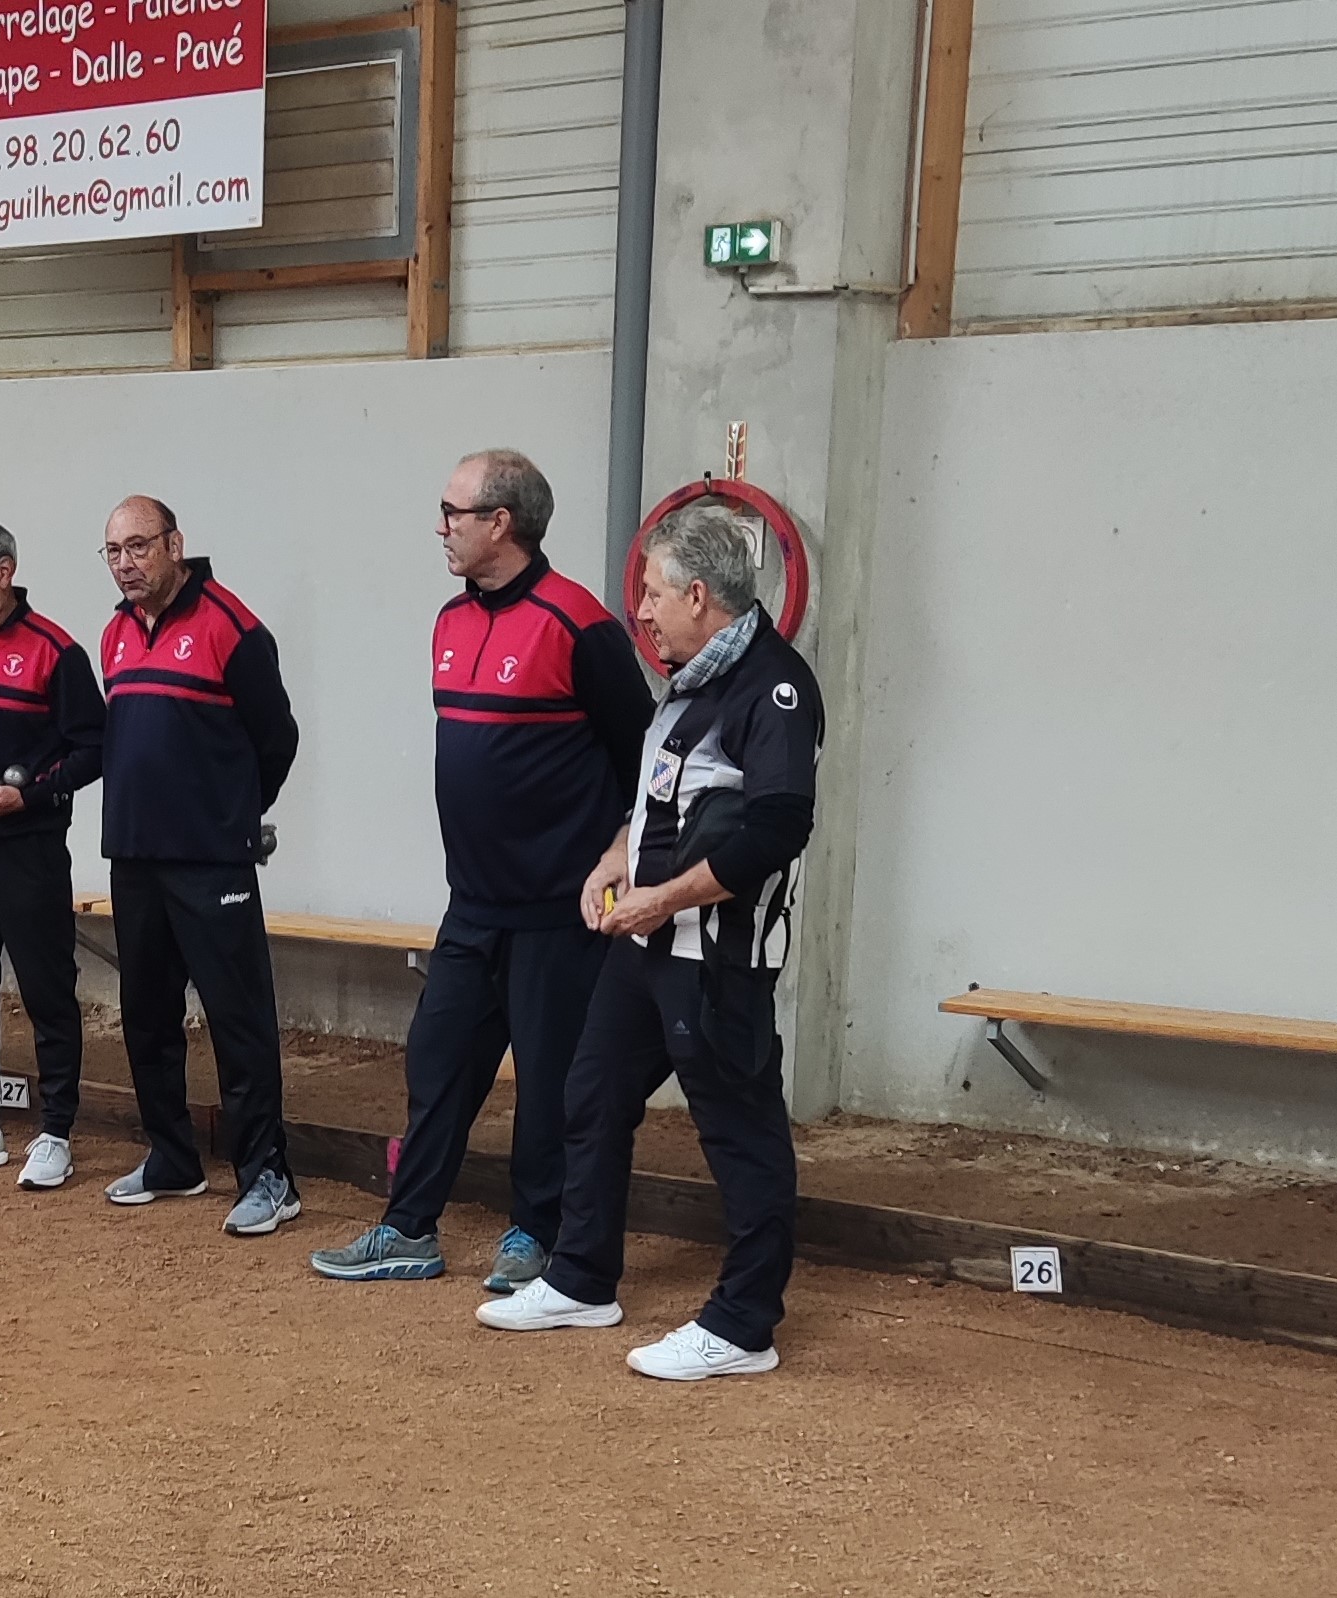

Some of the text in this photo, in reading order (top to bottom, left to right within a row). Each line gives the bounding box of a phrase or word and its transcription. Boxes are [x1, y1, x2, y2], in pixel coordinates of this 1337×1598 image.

[72, 39, 144, 87] Dalle
[176, 20, 244, 73] Pavé
[2, 1081, 26, 1102] 27
[1019, 1260, 1053, 1285] 26
